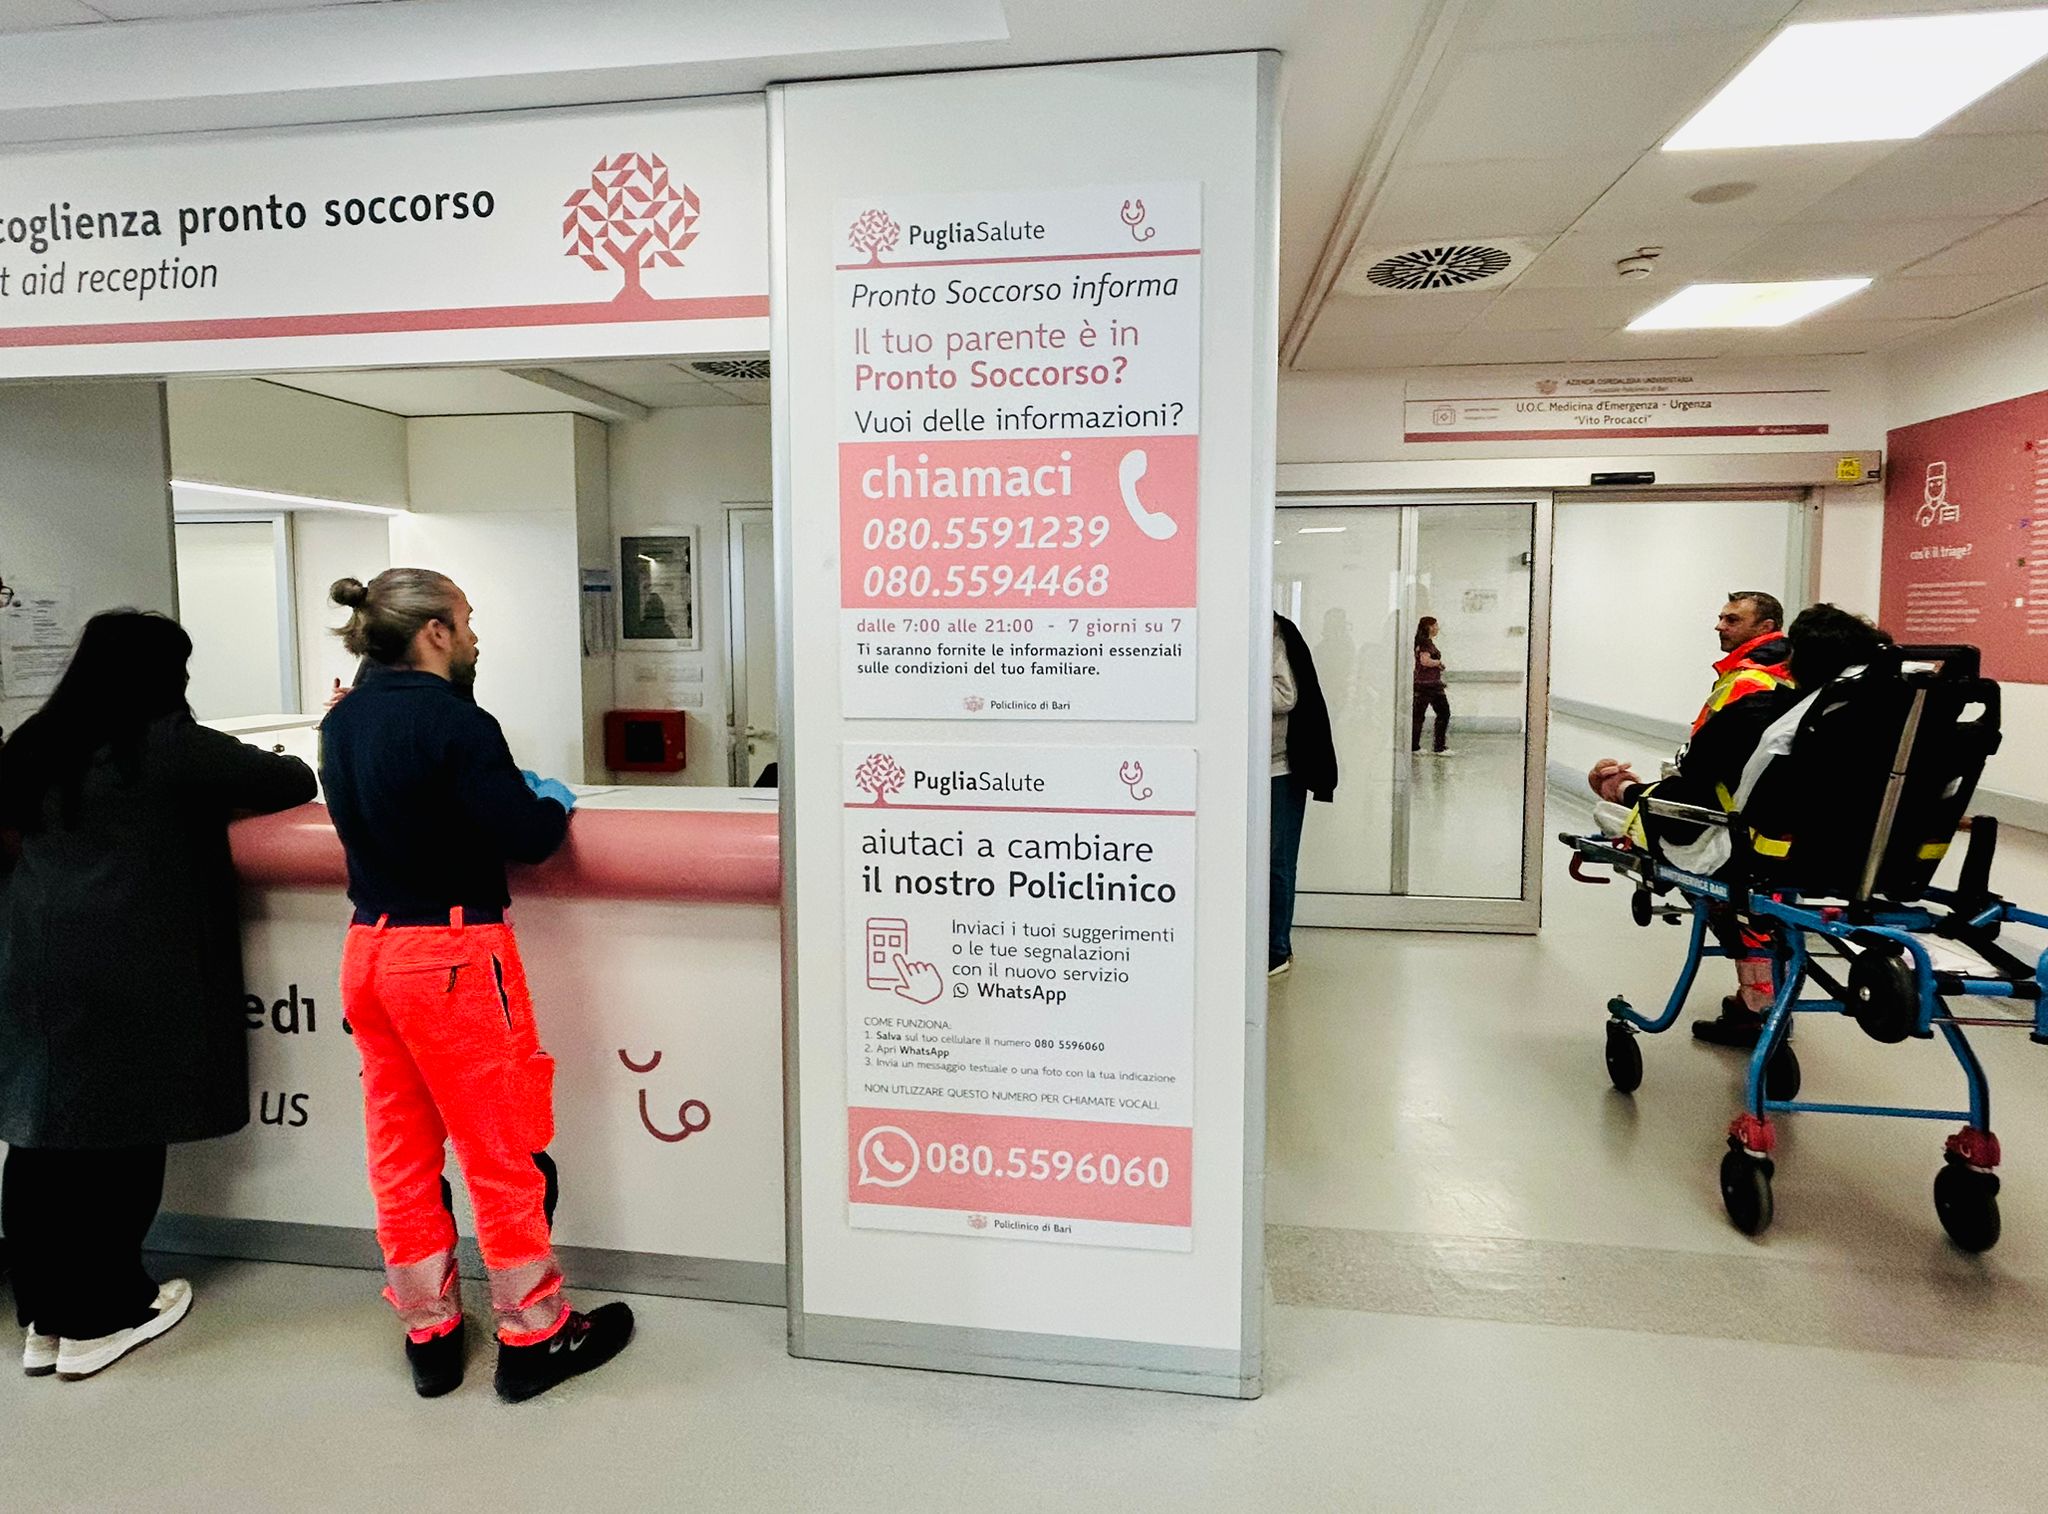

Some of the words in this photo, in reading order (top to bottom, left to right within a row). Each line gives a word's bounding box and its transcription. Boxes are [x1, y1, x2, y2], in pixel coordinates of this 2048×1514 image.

[179, 194, 306, 247] pronto
[325, 191, 494, 226] soccorso
[910, 221, 1044, 250] PugliaSalute
[22, 261, 65, 295] aid
[78, 257, 217, 300] reception
[852, 284, 935, 307] Pronto
[946, 280, 1060, 304] Soccorso
[1073, 273, 1178, 306] informa
[856, 328, 870, 354] Il
[882, 329, 932, 353] tuo
[947, 324, 1065, 360] parente
[1080, 320, 1096, 347] è
[1111, 319, 1137, 346] in
[857, 364, 956, 391] Pronto
[971, 356, 1127, 387] Soccorso?
[1550, 402, 1593, 411] Medicina
[1670, 400, 1712, 411] Urgenza
[855, 410, 910, 433] Vuoi
[924, 409, 984, 432] delle
[997, 403, 1183, 430] informazioni?
[862, 451, 1072, 498] chiamaci
[864, 516, 1109, 550] 080.5591239
[864, 564, 1109, 597] 080.5594468
[857, 619, 895, 632] dalle
[903, 619, 939, 632] 7:00
[948, 619, 976, 632] alle
[985, 619, 1033, 632] 21:00
[1069, 619, 1078, 632] 7
[1087, 619, 1136, 637] giorni
[1145, 623, 1162, 632] su
[1171, 619, 1181, 632] 7
[857, 643, 869, 654] Ti
[877, 647, 931, 655] saranno
[938, 643, 985, 656] fornite
[993, 644, 1003, 656] le
[1010, 643, 1102, 656] informazioni
[1110, 644, 1181, 656] essenziali
[858, 662, 889, 673] sulle
[895, 662, 967, 674] condizioni
[974, 662, 994, 674] del
[1001, 663, 1024, 674] tuo
[1031, 662, 1099, 675] familiare.
[991, 701, 1036, 709] Policlinico
[1052, 701, 1070, 709] Bari
[915, 771, 1044, 795] PugliaSalute
[863, 829, 962, 856] aiutaci
[978, 839, 994, 857] a
[1008, 833, 1153, 862] cambiare
[863, 866, 882, 892] il
[896, 871, 994, 896] nostro
[1010, 871, 1175, 903] Policlinico
[953, 920, 1004, 935] Inviaci
[1012, 922, 1015, 935] i
[1023, 924, 1055, 937] tuoi
[1063, 926, 1173, 943] suggerimenti
[953, 944, 962, 954] o
[970, 941, 983, 955] le
[990, 943, 1017, 957] tue
[1025, 945, 1129, 963] segnalazioni
[953, 965, 981, 975] con
[989, 963, 998, 977] il
[1006, 967, 1056, 979] nuovo
[1064, 968, 1128, 982] servizio
[977, 983, 1066, 1005] WhatsApp
[864, 1017, 893, 1027] COME
[877, 1031, 901, 1040] Salva
[905, 1033, 918, 1041] sul
[941, 1035, 981, 1045] cellulare
[1035, 1039, 1054, 1048] 080
[1059, 1041, 1104, 1051] 5596060
[877, 1045, 896, 1054] Apri
[900, 1046, 949, 1058] WhatsApp
[877, 1058, 898, 1067] Invia
[917, 1062, 966, 1073] messaggio
[970, 1064, 1007, 1073] testuale
[1042, 1067, 1062, 1076] foto
[1087, 1070, 1095, 1078] la
[1120, 1072, 1176, 1083] indicazione
[865, 1084, 888, 1093] NON
[947, 1089, 988, 1099] QUESTO
[992, 1091, 1037, 1102] NUMERO
[1041, 1094, 1059, 1103] PER
[1063, 1095, 1114, 1107] CHIAMATE
[259, 1090, 310, 1127] us
[927, 1143, 1168, 1188] 080.5596060
[994, 1220, 1038, 1231] Policlinico
[1054, 1224, 1071, 1233] Bari
